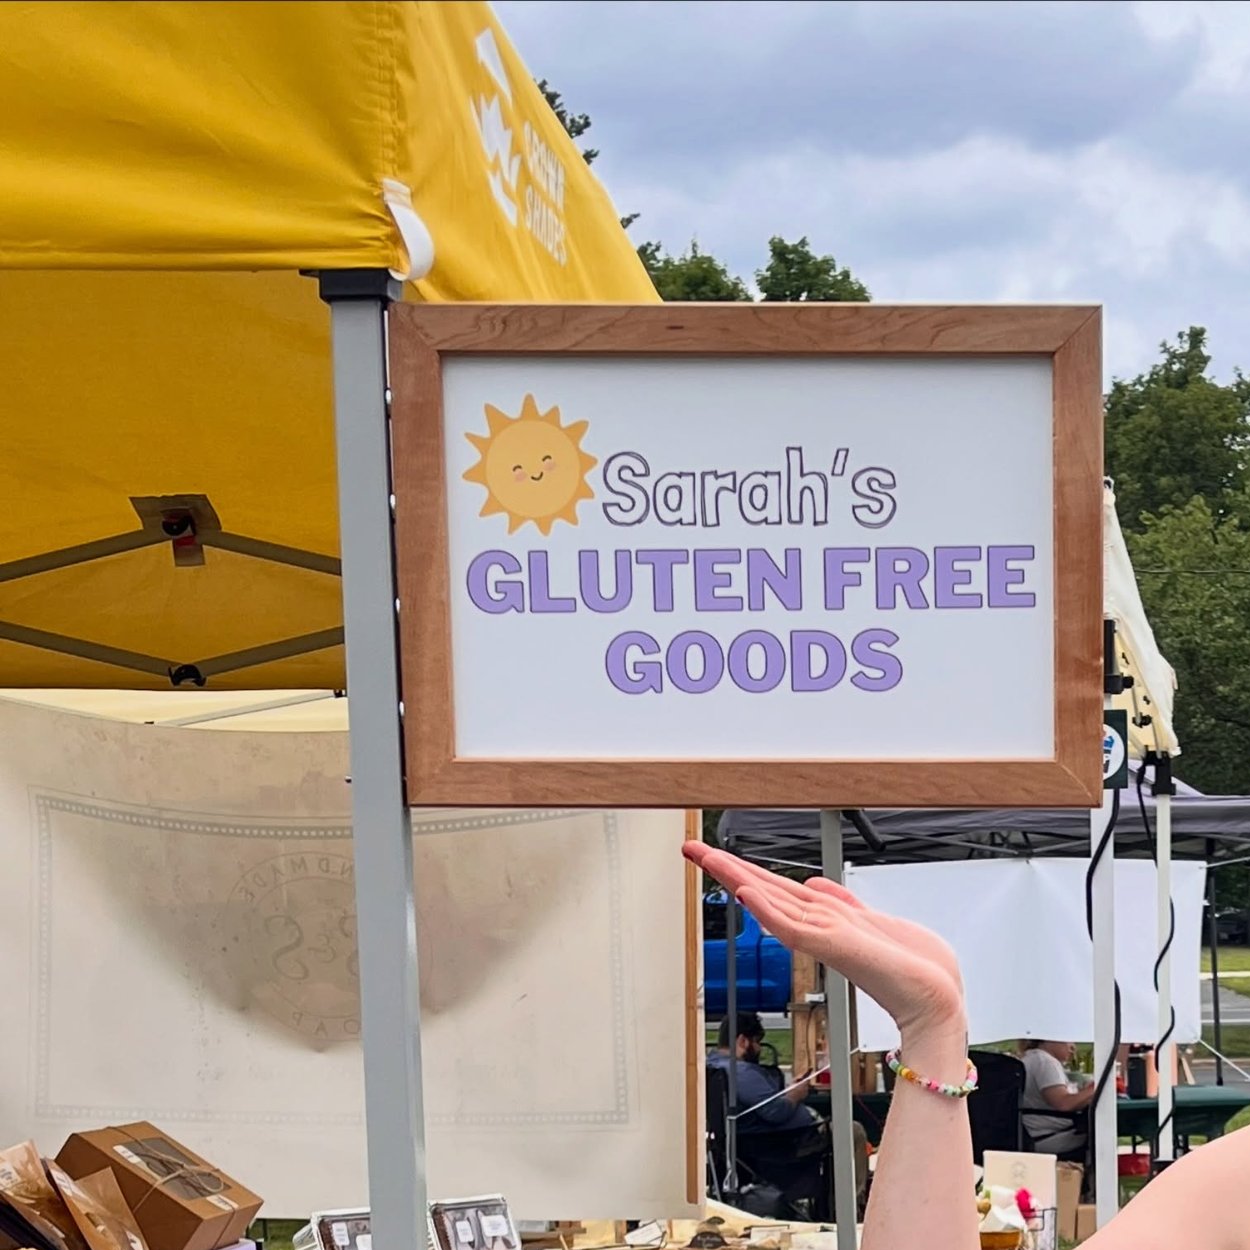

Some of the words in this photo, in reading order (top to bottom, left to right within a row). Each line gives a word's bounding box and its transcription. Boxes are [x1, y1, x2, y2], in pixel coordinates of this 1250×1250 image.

[601, 446, 896, 528] Sarah's
[466, 546, 801, 614] GLUTEN
[823, 545, 1037, 610] FREE
[604, 628, 904, 695] GOODS
